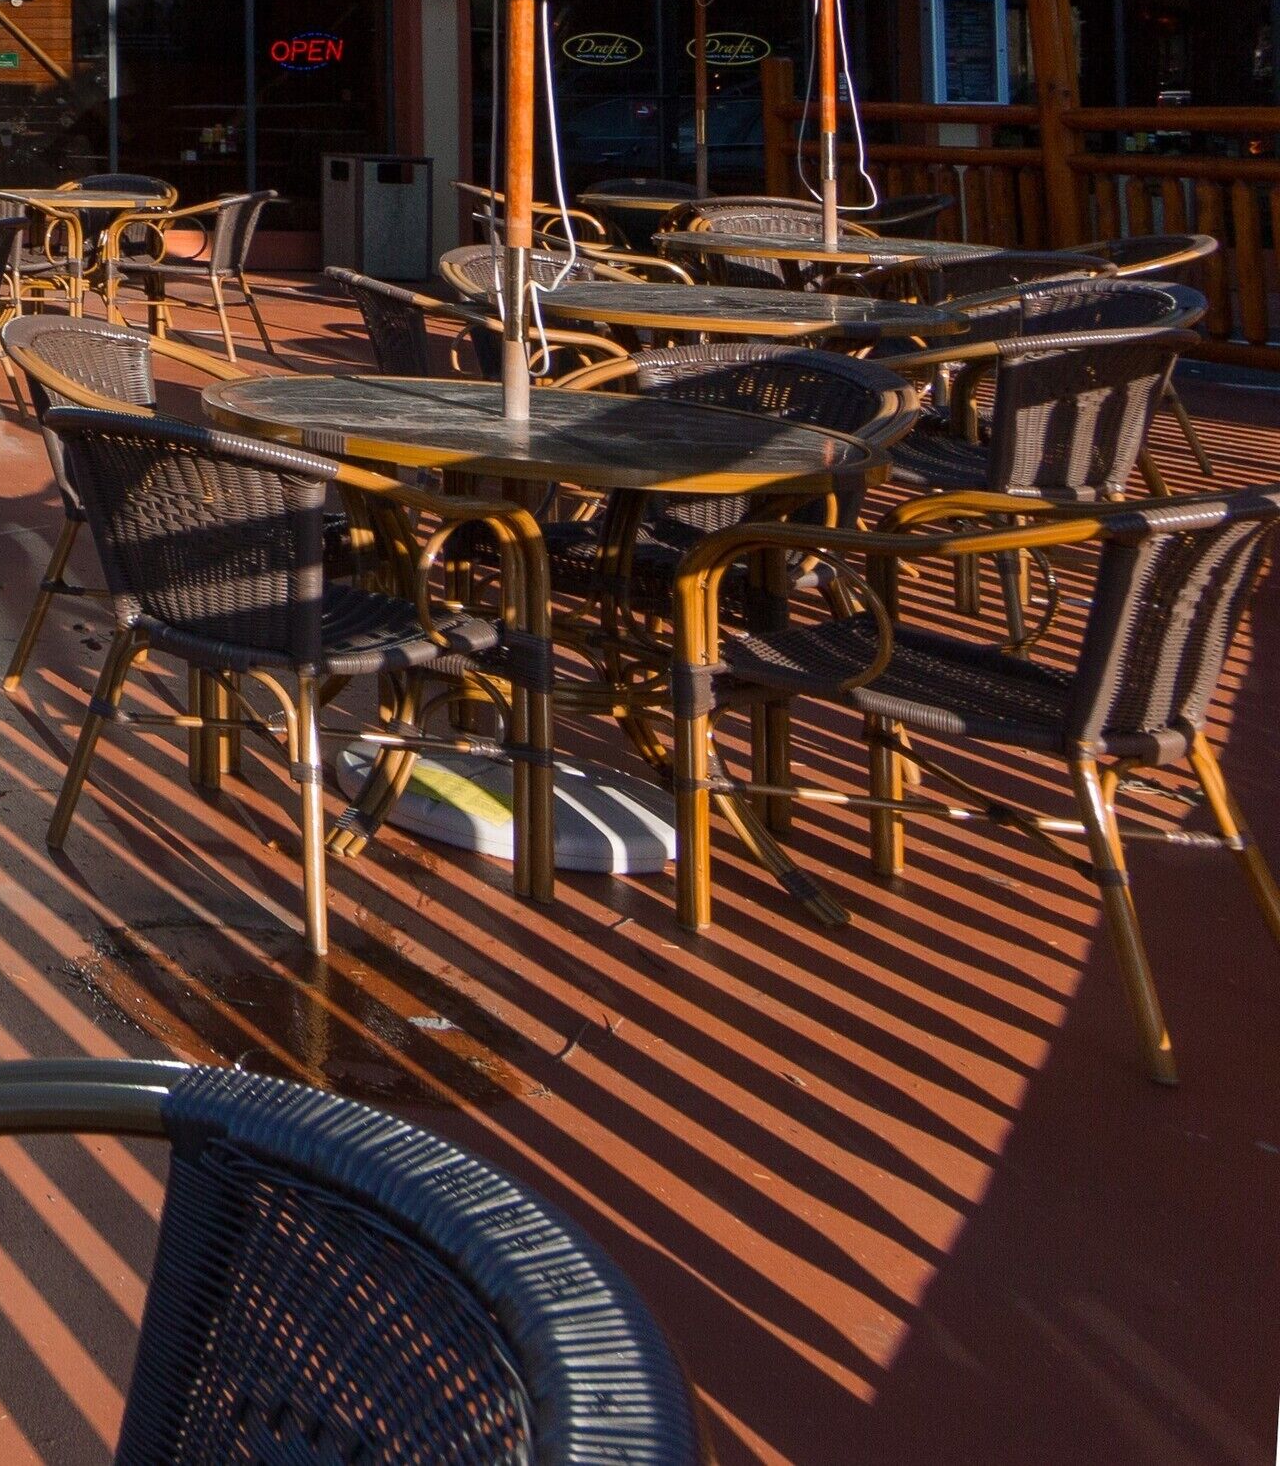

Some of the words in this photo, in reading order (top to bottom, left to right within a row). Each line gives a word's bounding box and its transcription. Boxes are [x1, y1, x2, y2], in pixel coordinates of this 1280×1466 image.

[271, 39, 344, 62] OPEN
[577, 36, 628, 62] Drafts
[705, 36, 755, 62] Drafts
